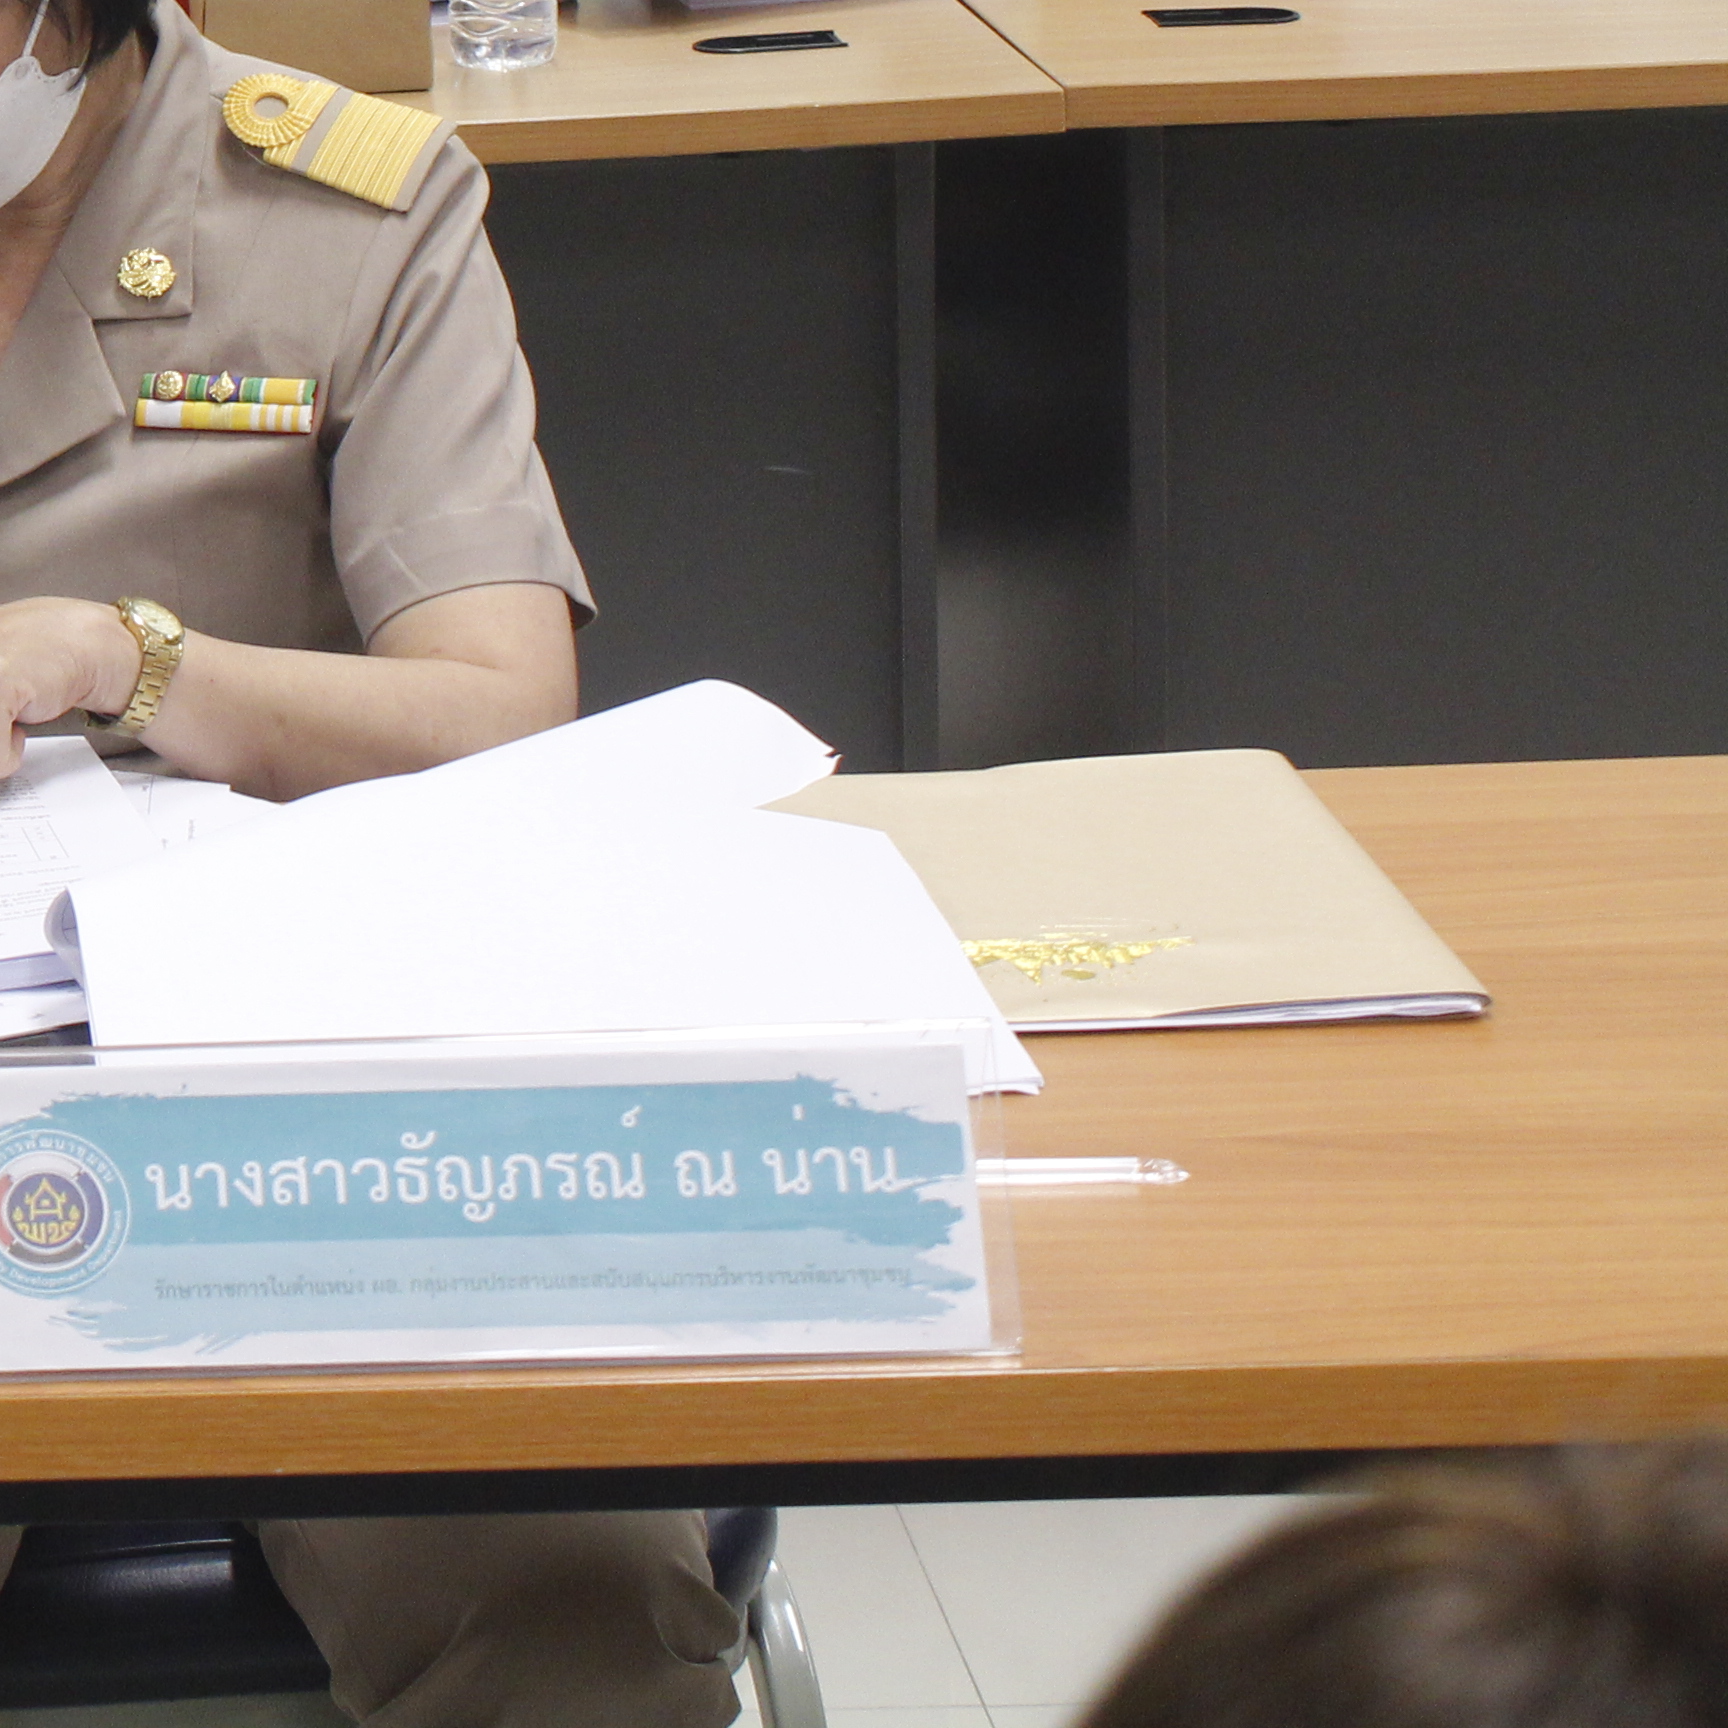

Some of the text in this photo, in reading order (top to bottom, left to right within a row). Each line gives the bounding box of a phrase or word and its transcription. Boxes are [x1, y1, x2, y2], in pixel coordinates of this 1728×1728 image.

[144, 1105, 900, 1222] นางสาวธัญภรณ์ ณ น่าน
